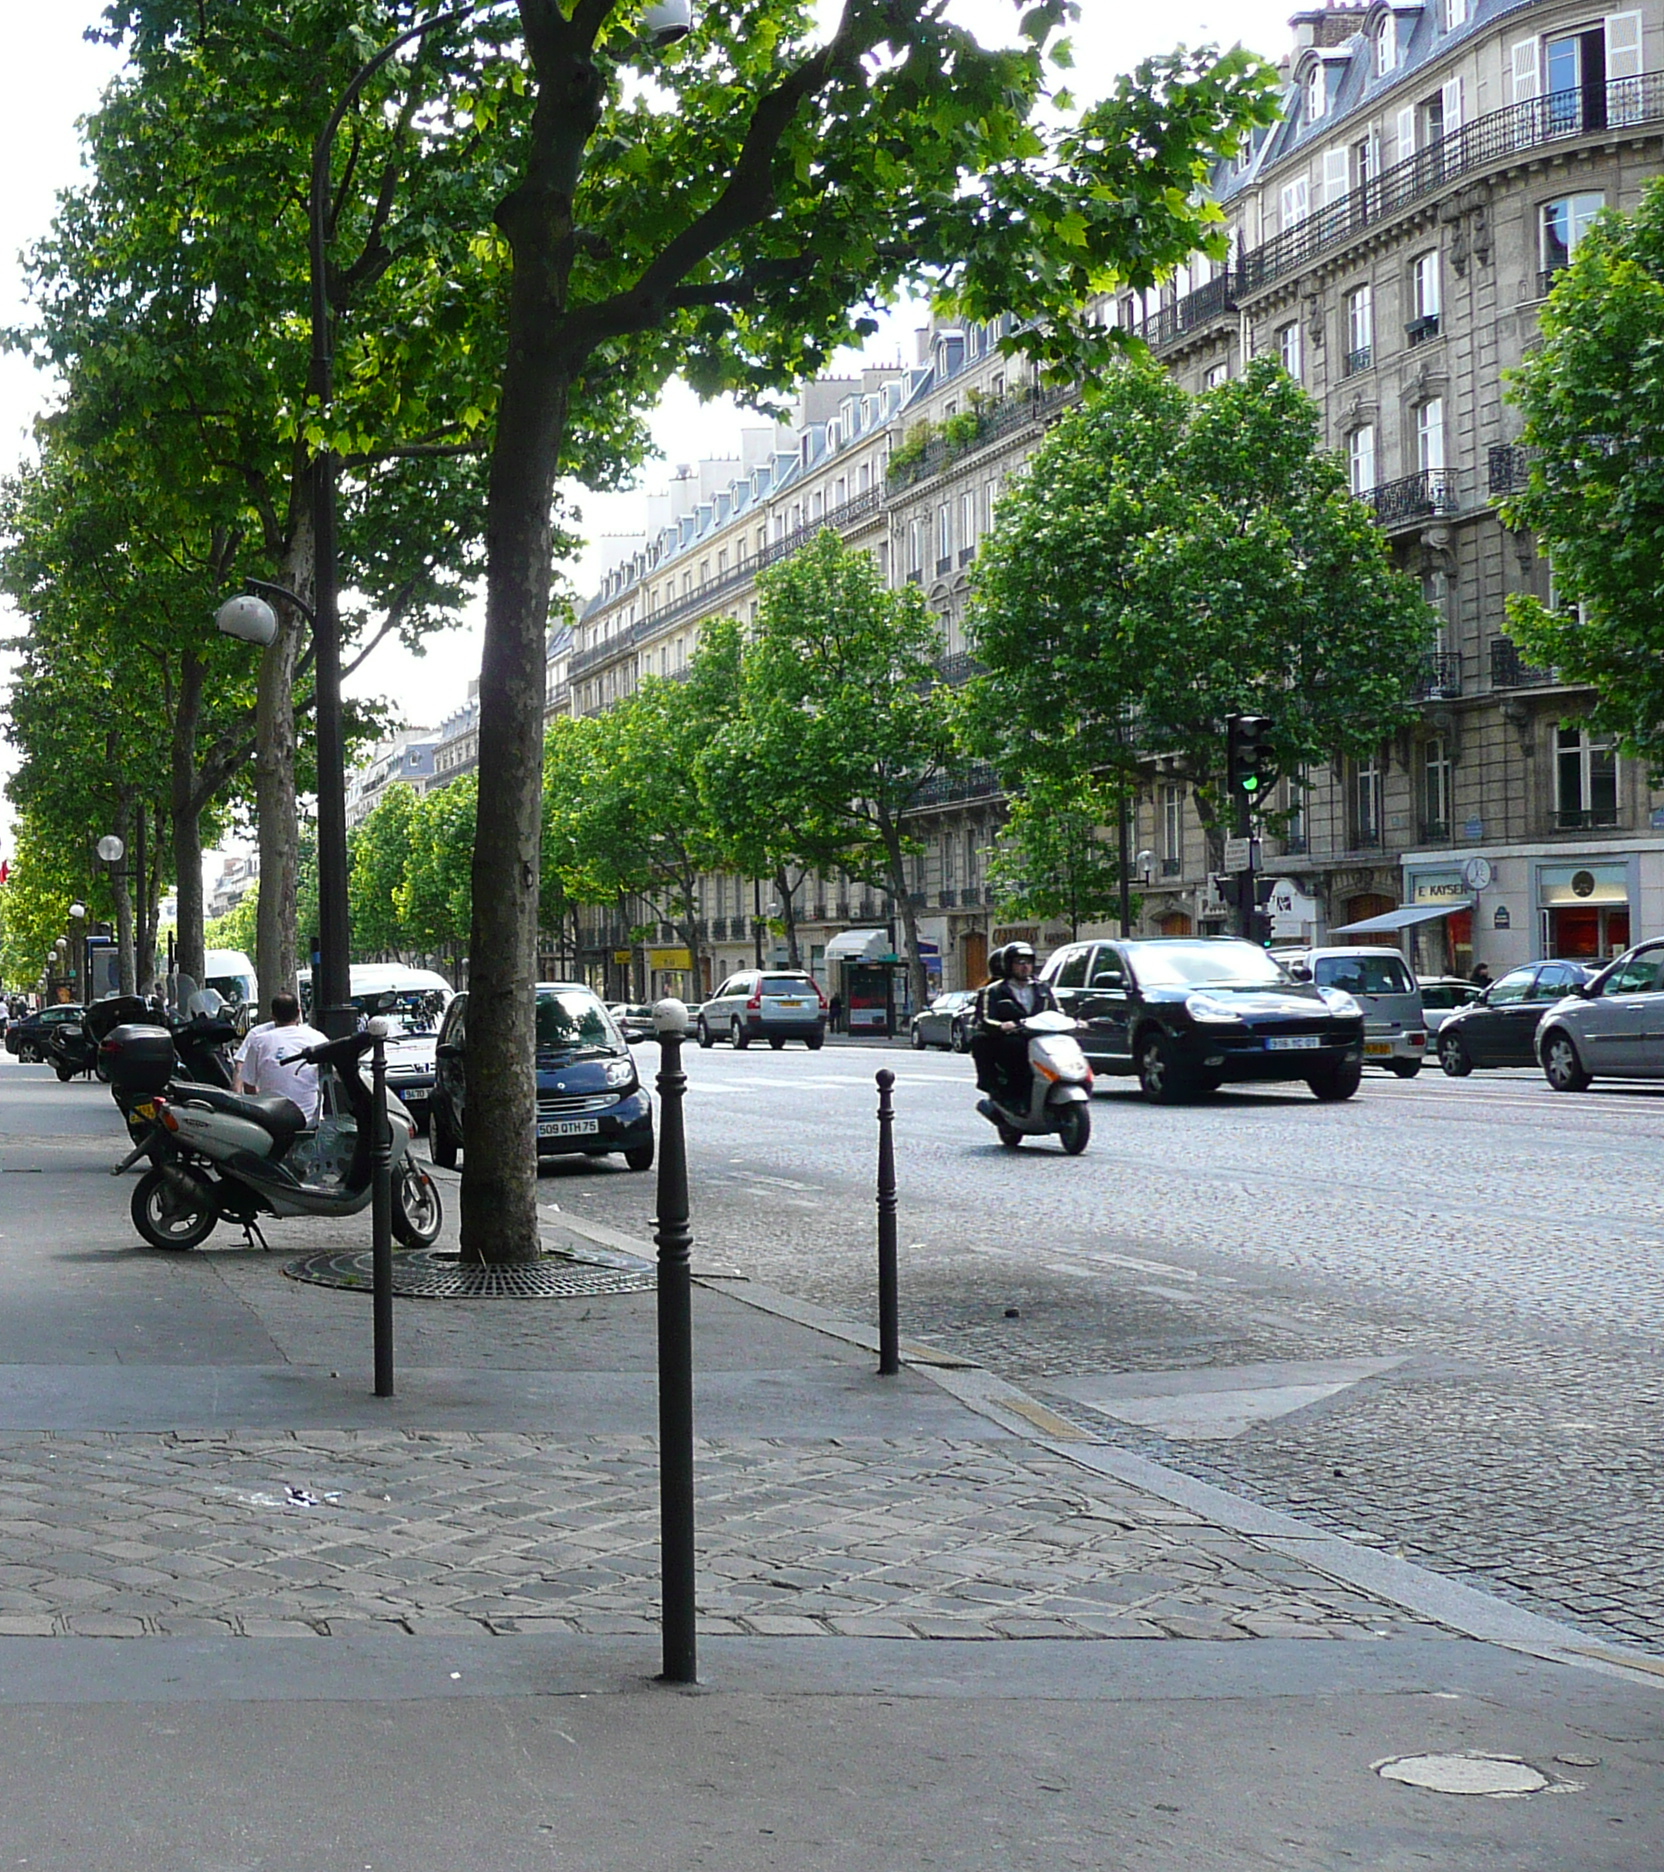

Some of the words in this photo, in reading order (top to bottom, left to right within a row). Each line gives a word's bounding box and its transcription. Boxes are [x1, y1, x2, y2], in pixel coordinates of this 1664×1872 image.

[1430, 884, 1468, 896] KAYSER
[539, 1124, 559, 1135] 509
[583, 1121, 596, 1132] 75
